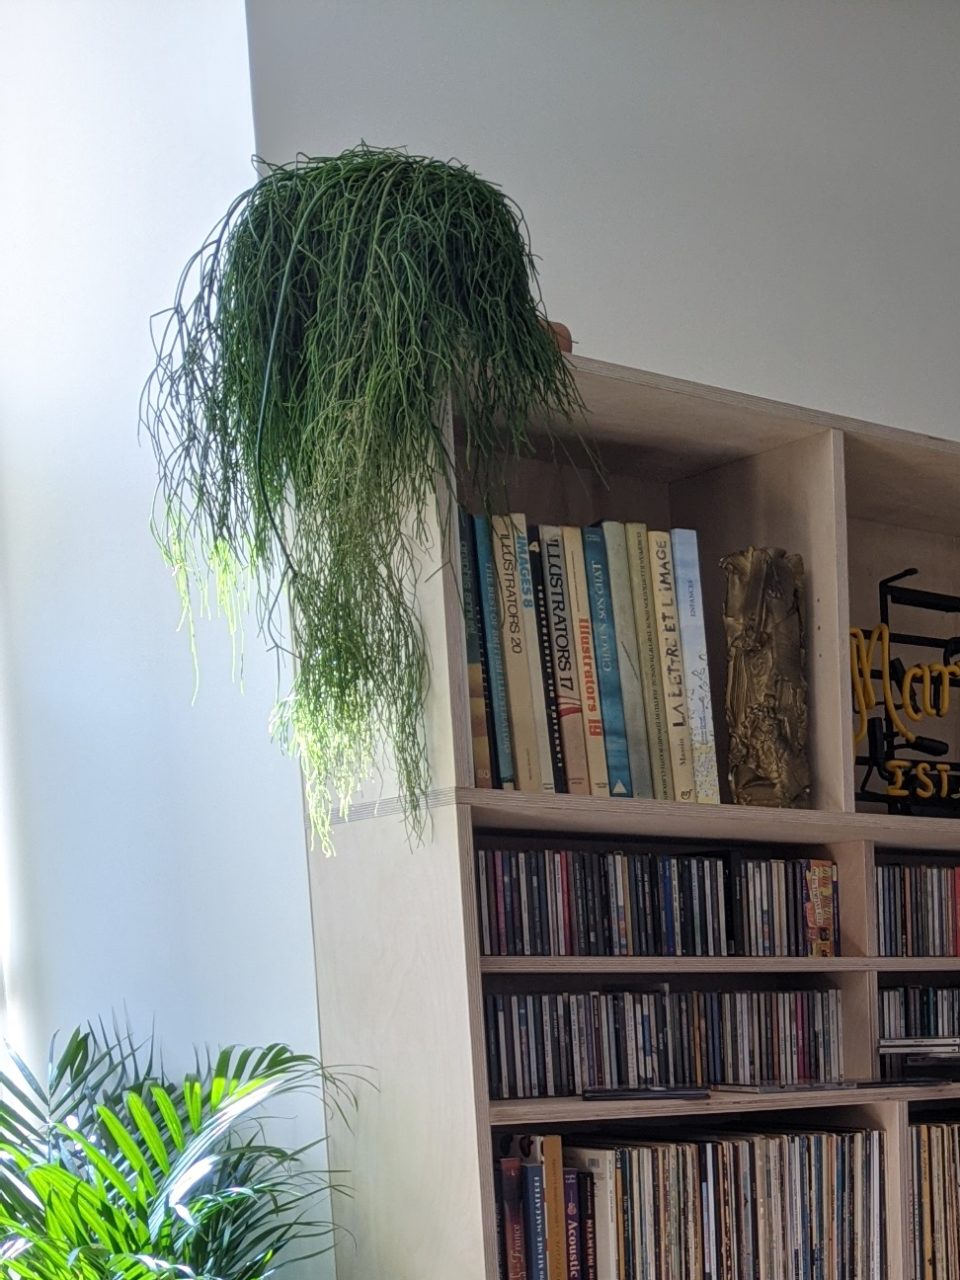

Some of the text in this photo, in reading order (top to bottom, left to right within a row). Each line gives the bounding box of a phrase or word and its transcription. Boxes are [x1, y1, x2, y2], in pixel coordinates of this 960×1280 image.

[487, 586, 496, 612] BEST
[500, 533, 522, 654] ILLUSTRATORS 20
[516, 535, 533, 609] IMAGES 8
[546, 538, 574, 692] ILLUSTRATORS 17
[590, 560, 612, 672] CHACUN SON CHAT
[661, 611, 676, 633] ET
[578, 617, 603, 737] Illustrators 19
[510, 1223, 523, 1263] France
[567, 1219, 580, 1278] Acoustic
[586, 1219, 595, 1266] MARTIN
